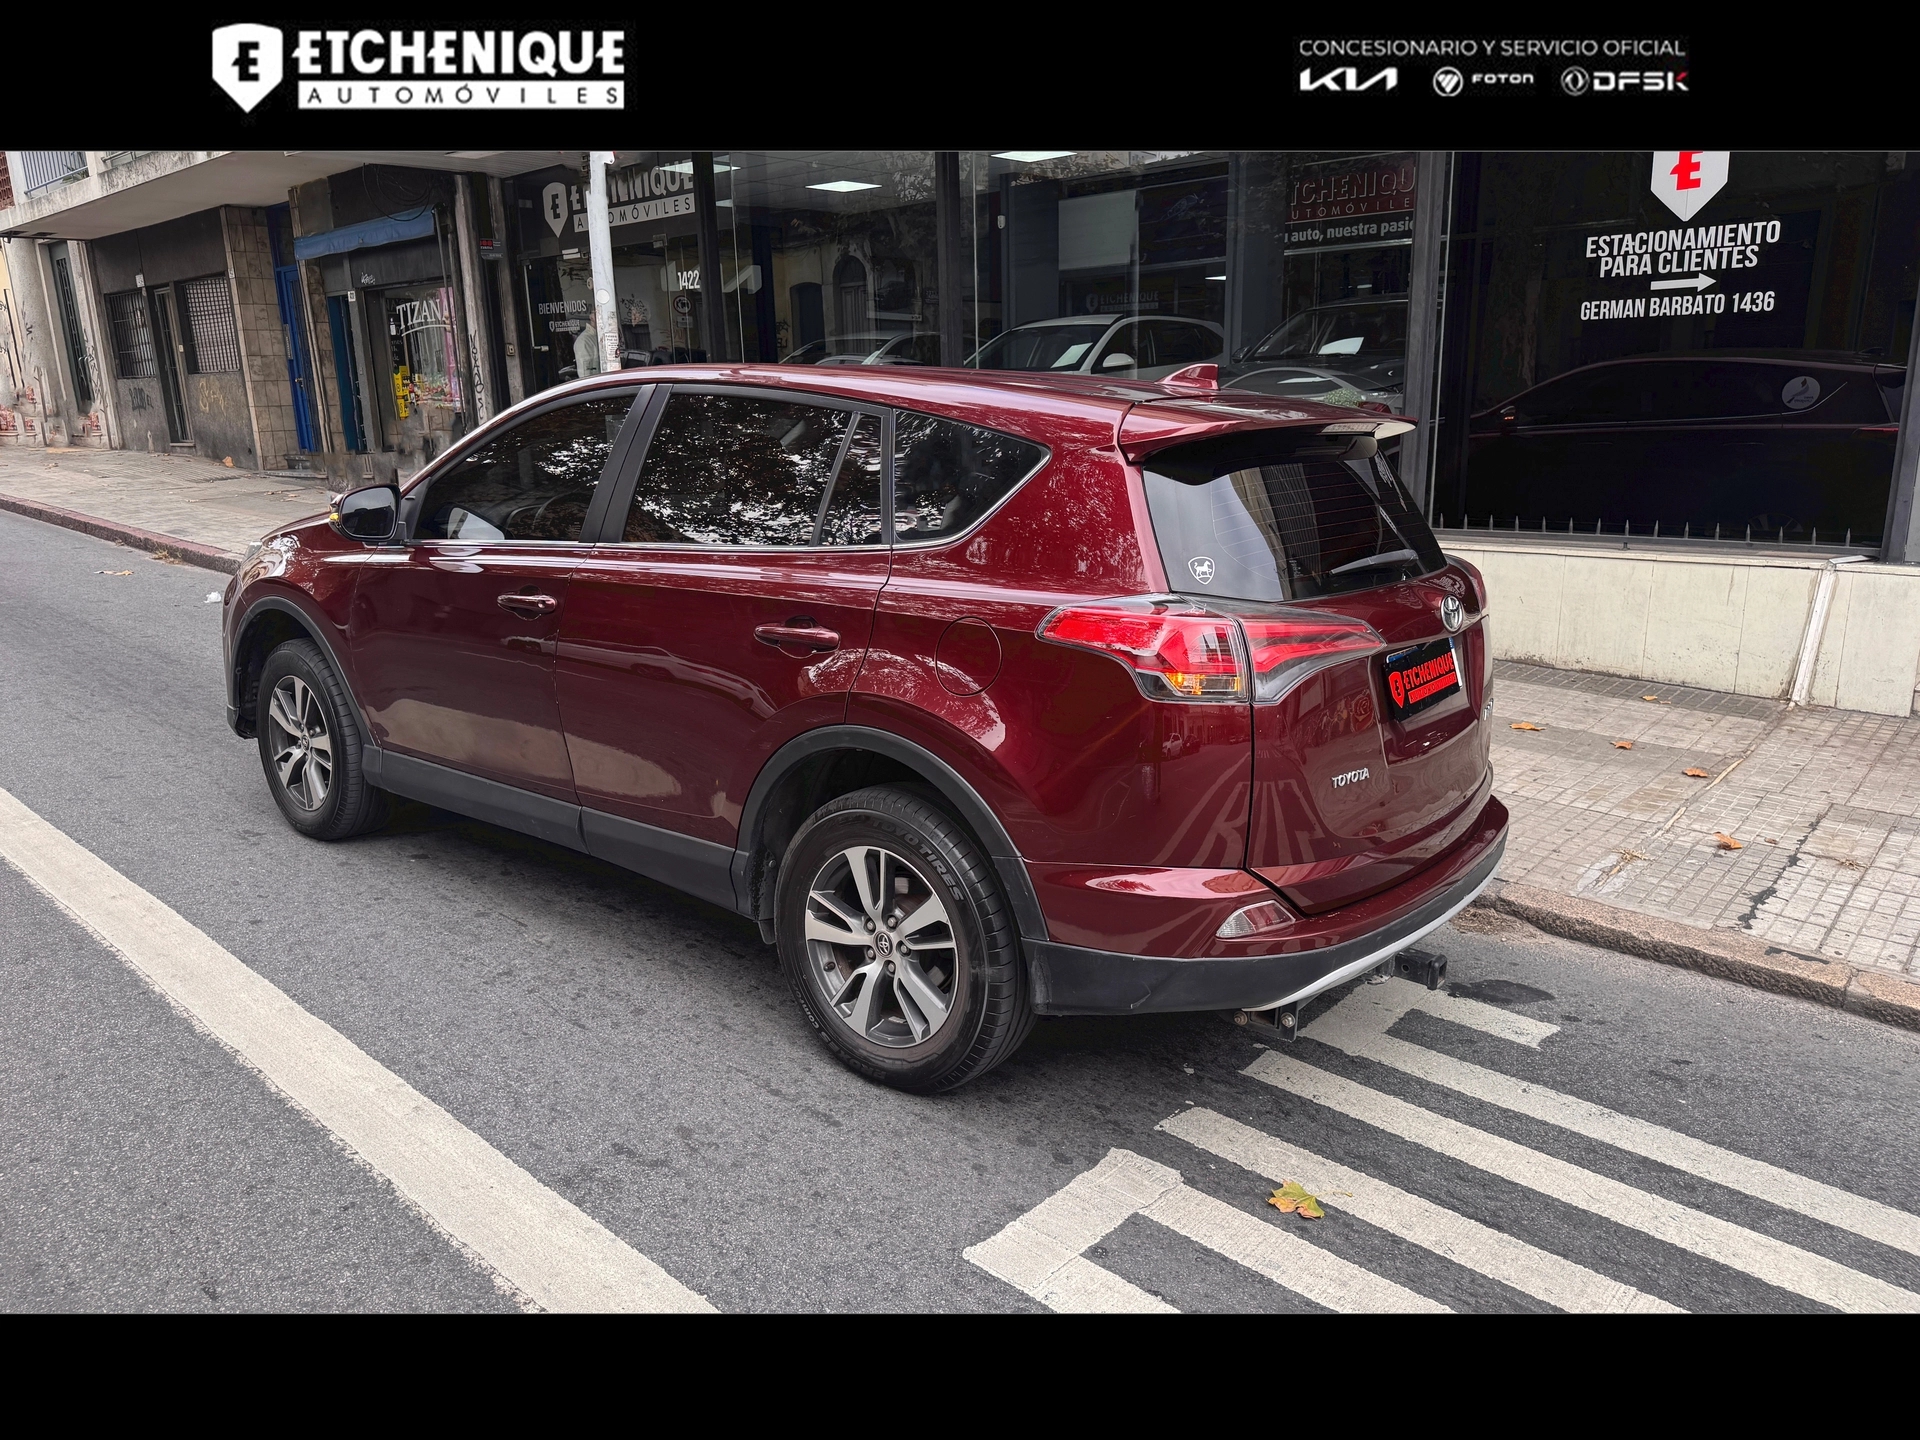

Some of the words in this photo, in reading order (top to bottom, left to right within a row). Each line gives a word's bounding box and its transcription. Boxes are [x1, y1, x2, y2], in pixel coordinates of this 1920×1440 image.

[577, 197, 691, 229] AOMÓVILES
[1327, 222, 1378, 238] nuestra
[1585, 220, 1781, 258] ESTACIONAMIENTO
[1600, 254, 1652, 278] PARA
[1658, 245, 1759, 274] CLIENTES
[677, 271, 700, 290] 1422
[538, 300, 587, 315] BIENVENIDOS
[1580, 298, 1645, 321] GERMAN
[1649, 293, 1725, 317] BARBATO
[1732, 291, 1775, 313] 1436
[1332, 767, 1370, 789] TOYOTA
[919, 843, 964, 900] TIRES
